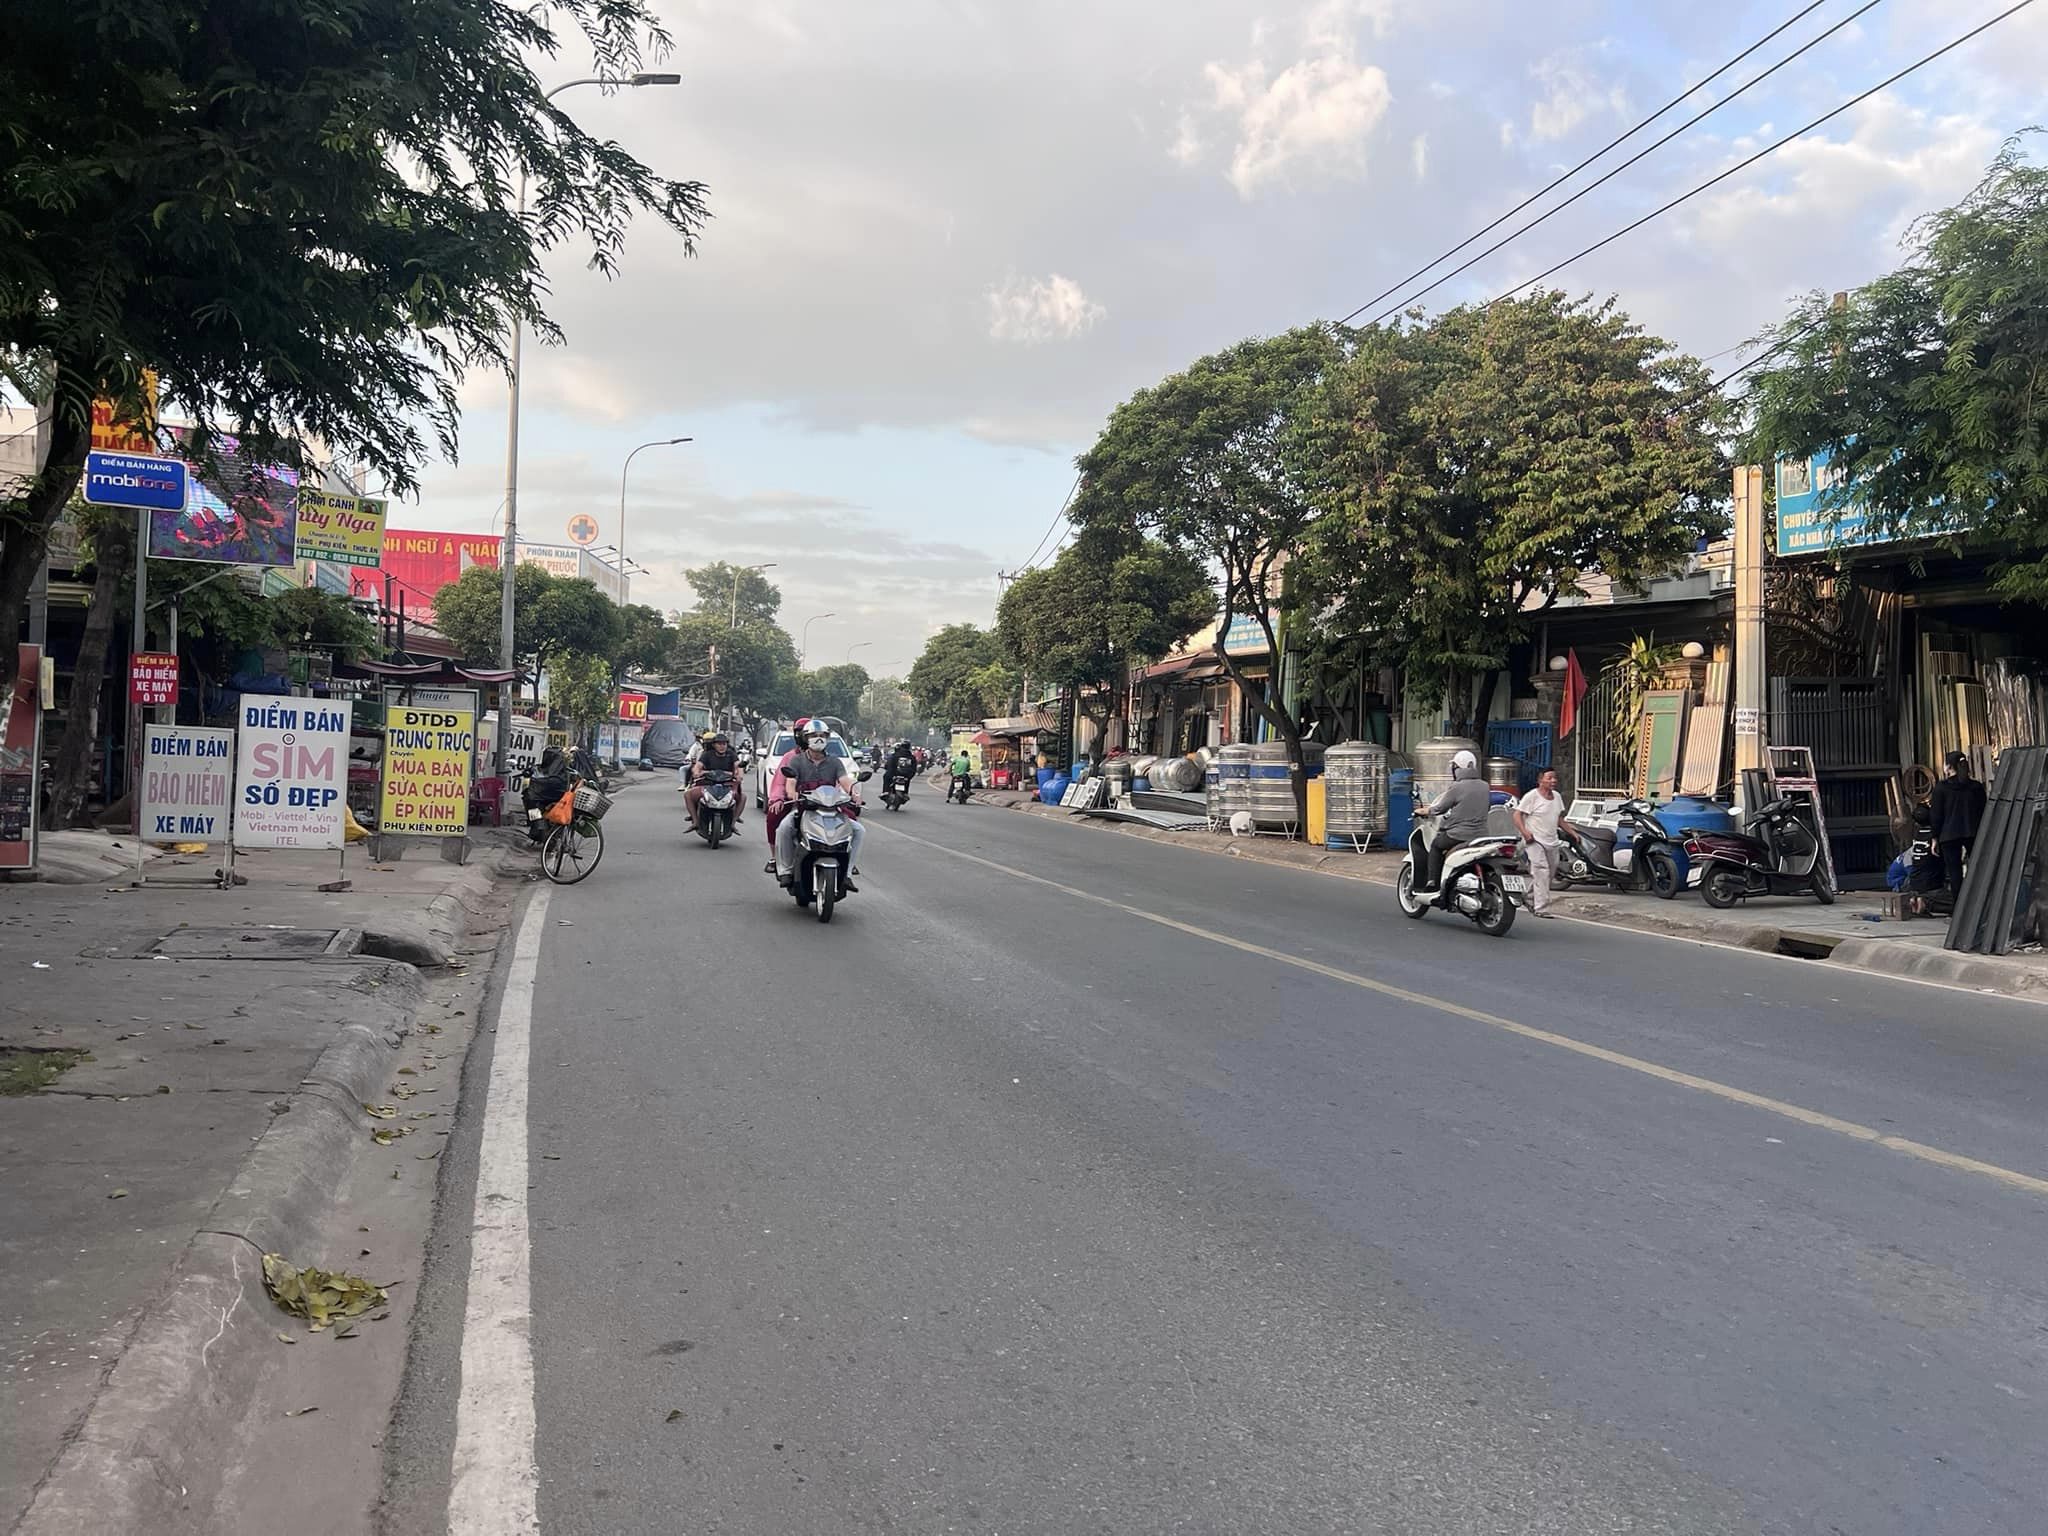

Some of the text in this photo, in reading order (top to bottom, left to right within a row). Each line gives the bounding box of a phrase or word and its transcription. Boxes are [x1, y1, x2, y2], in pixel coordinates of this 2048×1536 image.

[92, 473, 177, 491] mobifone
[336, 512, 376, 534] Nga
[406, 537, 439, 554] NGỮ
[443, 539, 453, 555] Á
[547, 560, 577, 573] PHƯỚC
[133, 665, 177, 680] BẢO HIỂM
[136, 681, 173, 692] XE MÁY
[246, 701, 344, 732] ĐIỂM BÁN
[405, 712, 458, 727] ĐTDĐ
[151, 731, 228, 757] ĐIỂM BÁN
[389, 728, 472, 756] TRUNG TRỰC
[252, 733, 334, 781] SIM
[392, 760, 426, 776] MUA
[431, 758, 463, 777] BÁN
[148, 761, 226, 806] BẢO HIỂM
[387, 775, 465, 799] SỬA CHỮA
[245, 780, 338, 811] SỐ ĐẸP
[240, 810, 265, 820] Mobi
[274, 811, 307, 821] Viettel
[316, 813, 338, 823] Vina
[395, 800, 455, 820] ÉP KÍNH
[155, 813, 214, 834] XE MÁY
[249, 822, 331, 834] Vietnam Mobi
[384, 822, 465, 833] PHỤ KIỆN ĐTDĐ
[276, 836, 300, 846] ITEL
